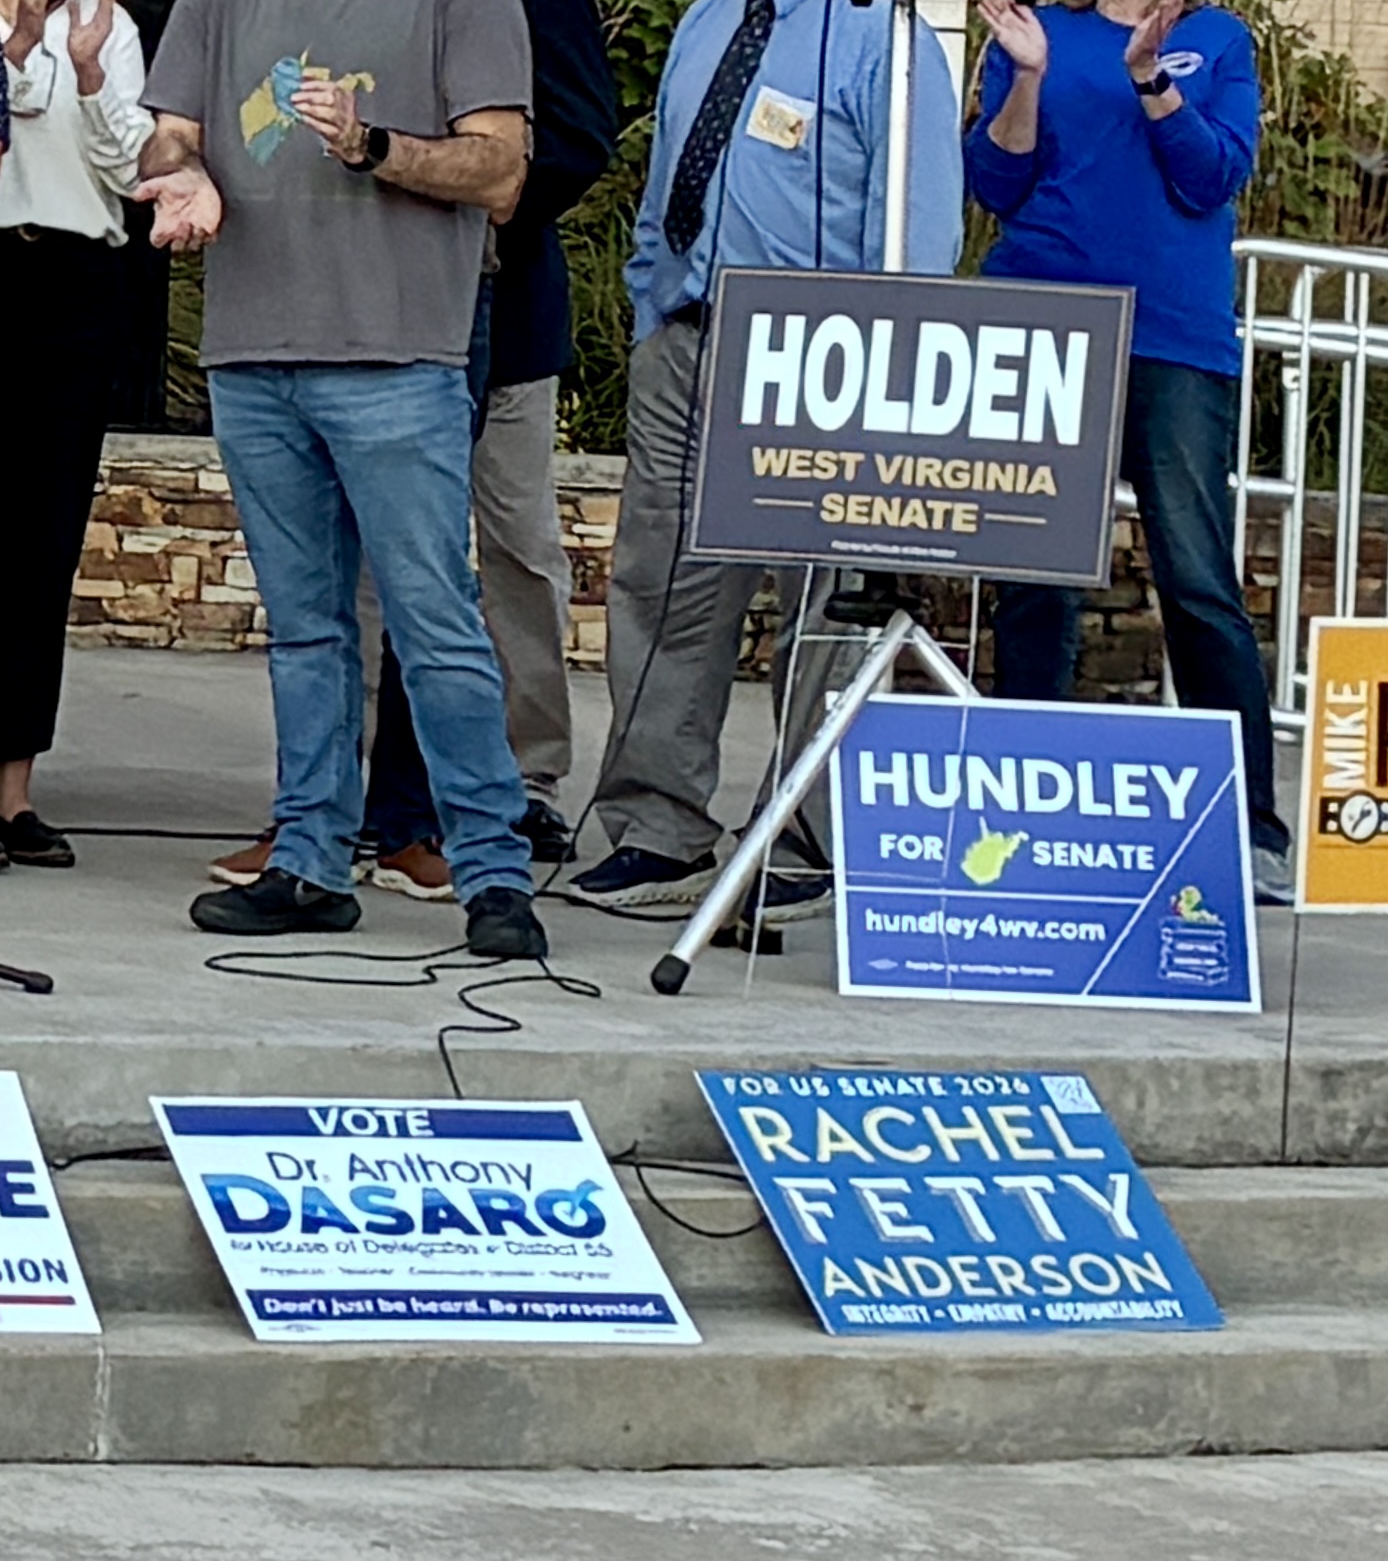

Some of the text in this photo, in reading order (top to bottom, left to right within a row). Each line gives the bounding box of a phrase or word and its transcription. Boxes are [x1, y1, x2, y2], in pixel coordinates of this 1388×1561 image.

[741, 313, 1090, 445] HOLDEN
[752, 446, 1057, 496] WEST VIRGINIA
[820, 494, 979, 532] SENATE
[1322, 679, 1369, 789] MIKE
[858, 750, 1198, 820] HUNDLEY
[880, 834, 1155, 871] FOR SENATE
[865, 908, 1106, 942] hundley4wv.com
[722, 1076, 782, 1096] FOR
[789, 1076, 830, 1096] US
[837, 1076, 948, 1096] SENATE
[954, 1076, 1030, 1096] 2026
[308, 1107, 435, 1137] VOTE
[738, 1105, 1105, 1164] RACHEL
[267, 1151, 533, 1191] Dr. Anthony
[201, 1173, 607, 1239] DASARO
[773, 1173, 1140, 1244] FETTY
[824, 1251, 1175, 1300] ANDERSON
[263, 1297, 326, 1314] Don't
[331, 1297, 373, 1316] just
[376, 1297, 406, 1313] be
